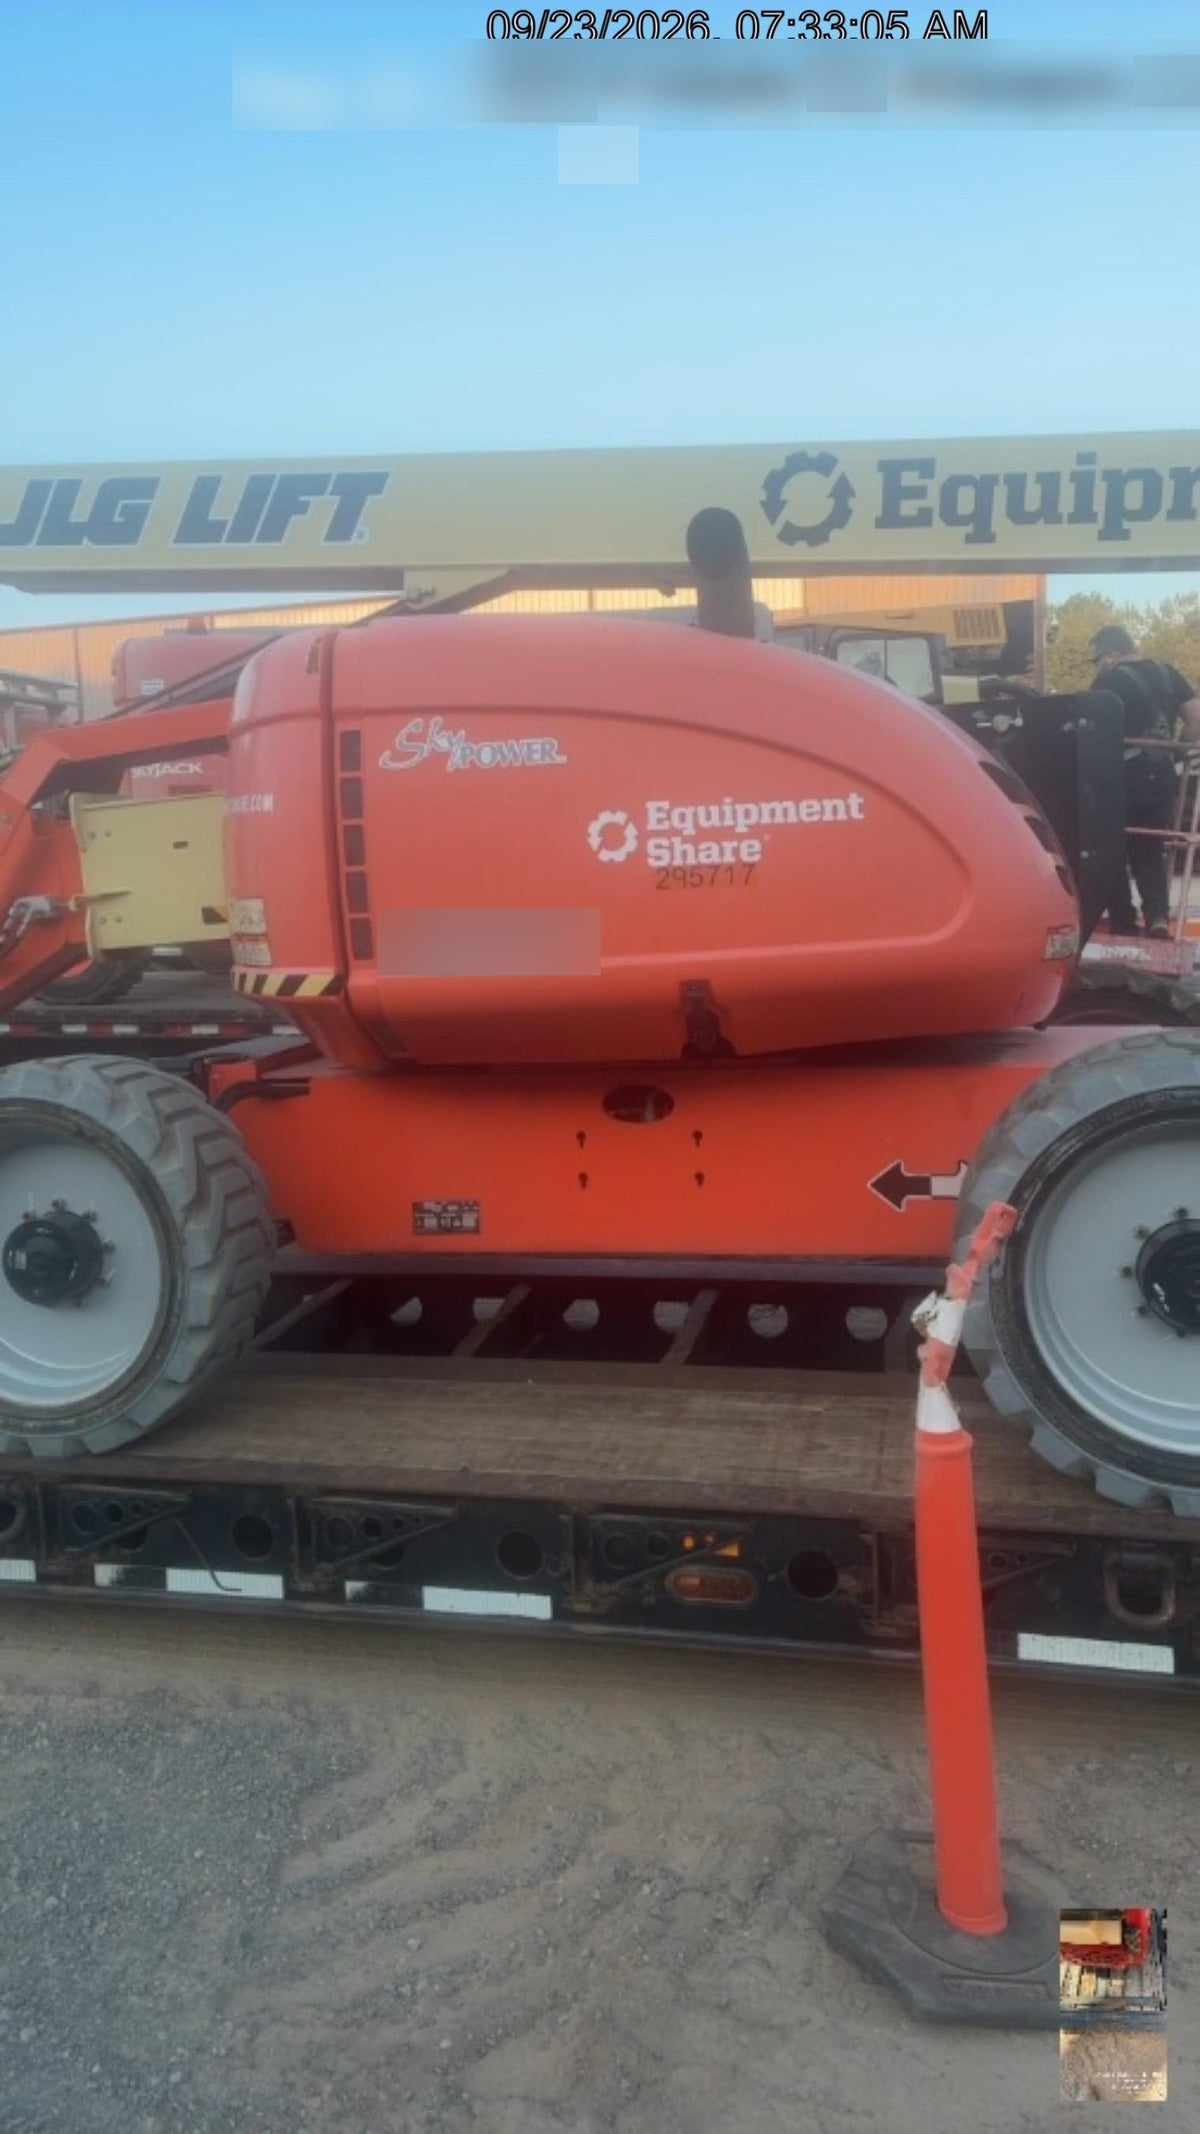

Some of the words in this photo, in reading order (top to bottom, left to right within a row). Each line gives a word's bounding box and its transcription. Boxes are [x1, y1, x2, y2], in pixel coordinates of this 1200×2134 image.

[0, 475, 162, 547] JLG
[171, 471, 391, 545] LIFT
[645, 792, 865, 835] Equipment
[647, 836, 762, 867] Share
[655, 863, 756, 890] 295717
